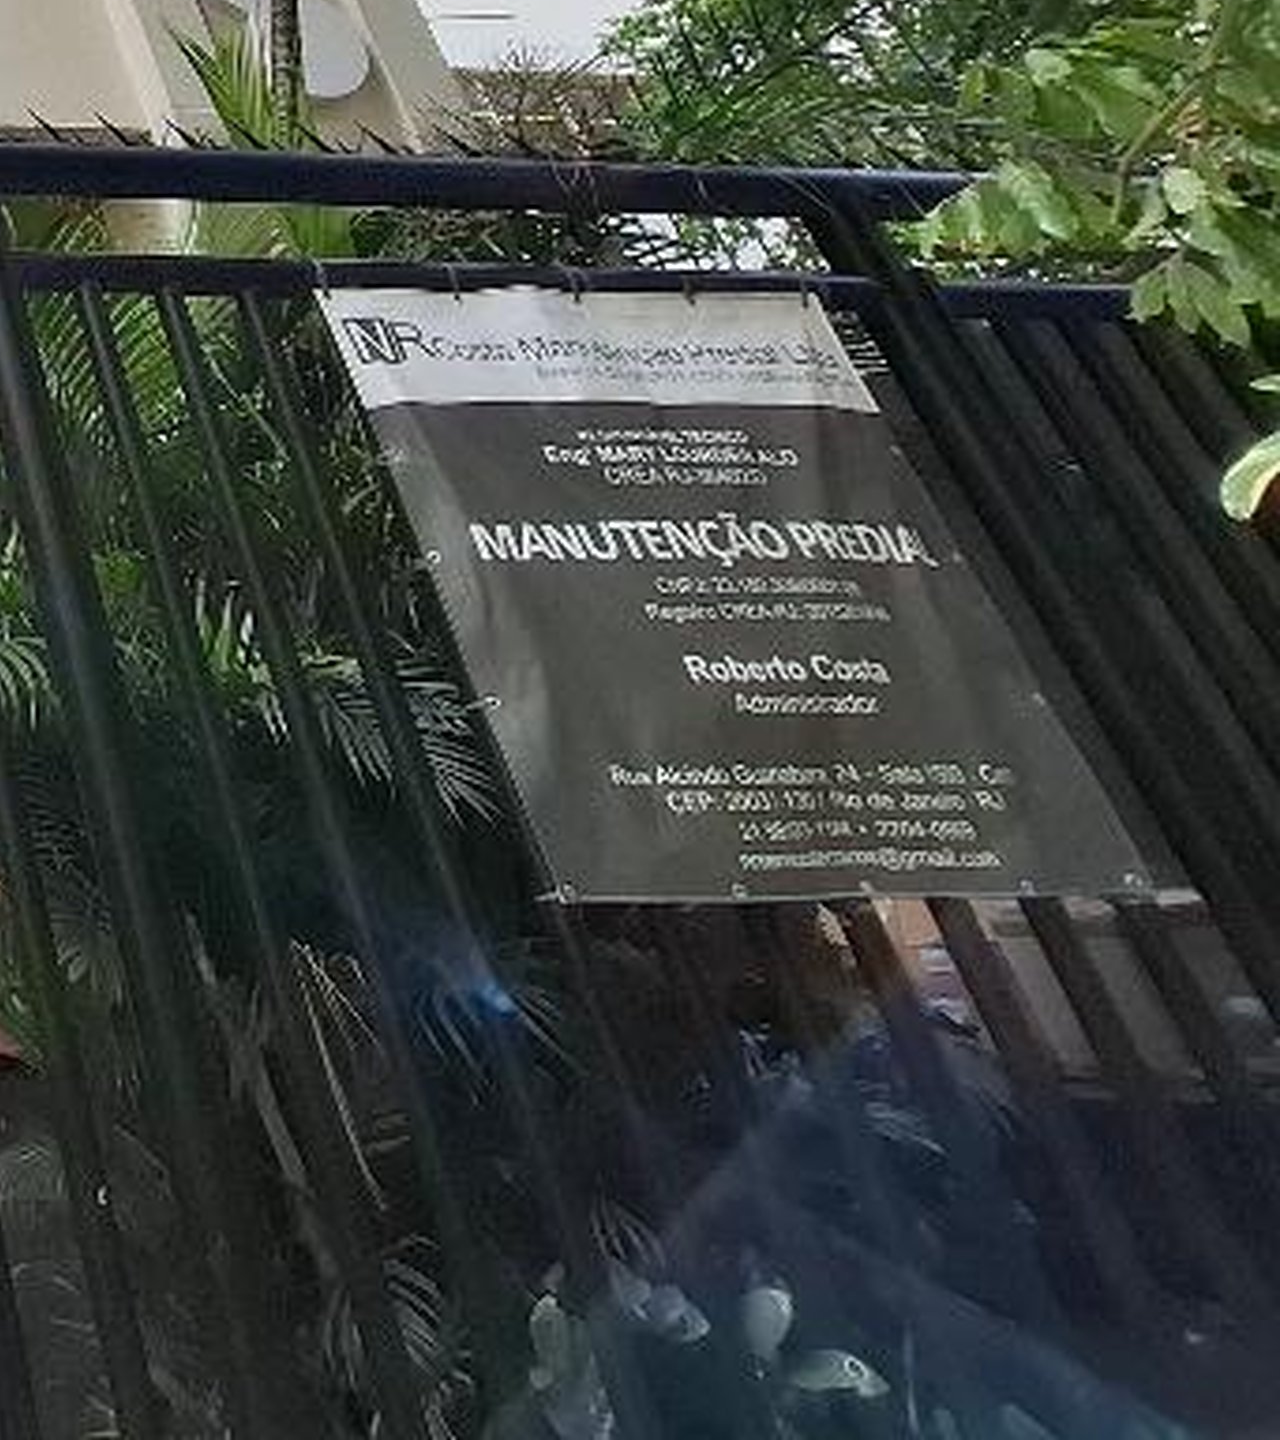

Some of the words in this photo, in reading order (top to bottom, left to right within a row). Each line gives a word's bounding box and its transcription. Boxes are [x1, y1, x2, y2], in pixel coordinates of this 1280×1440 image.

[468, 511, 788, 567] MANUTENÇÃO
[683, 655, 807, 683] Roberto
[810, 655, 891, 683] Costa
